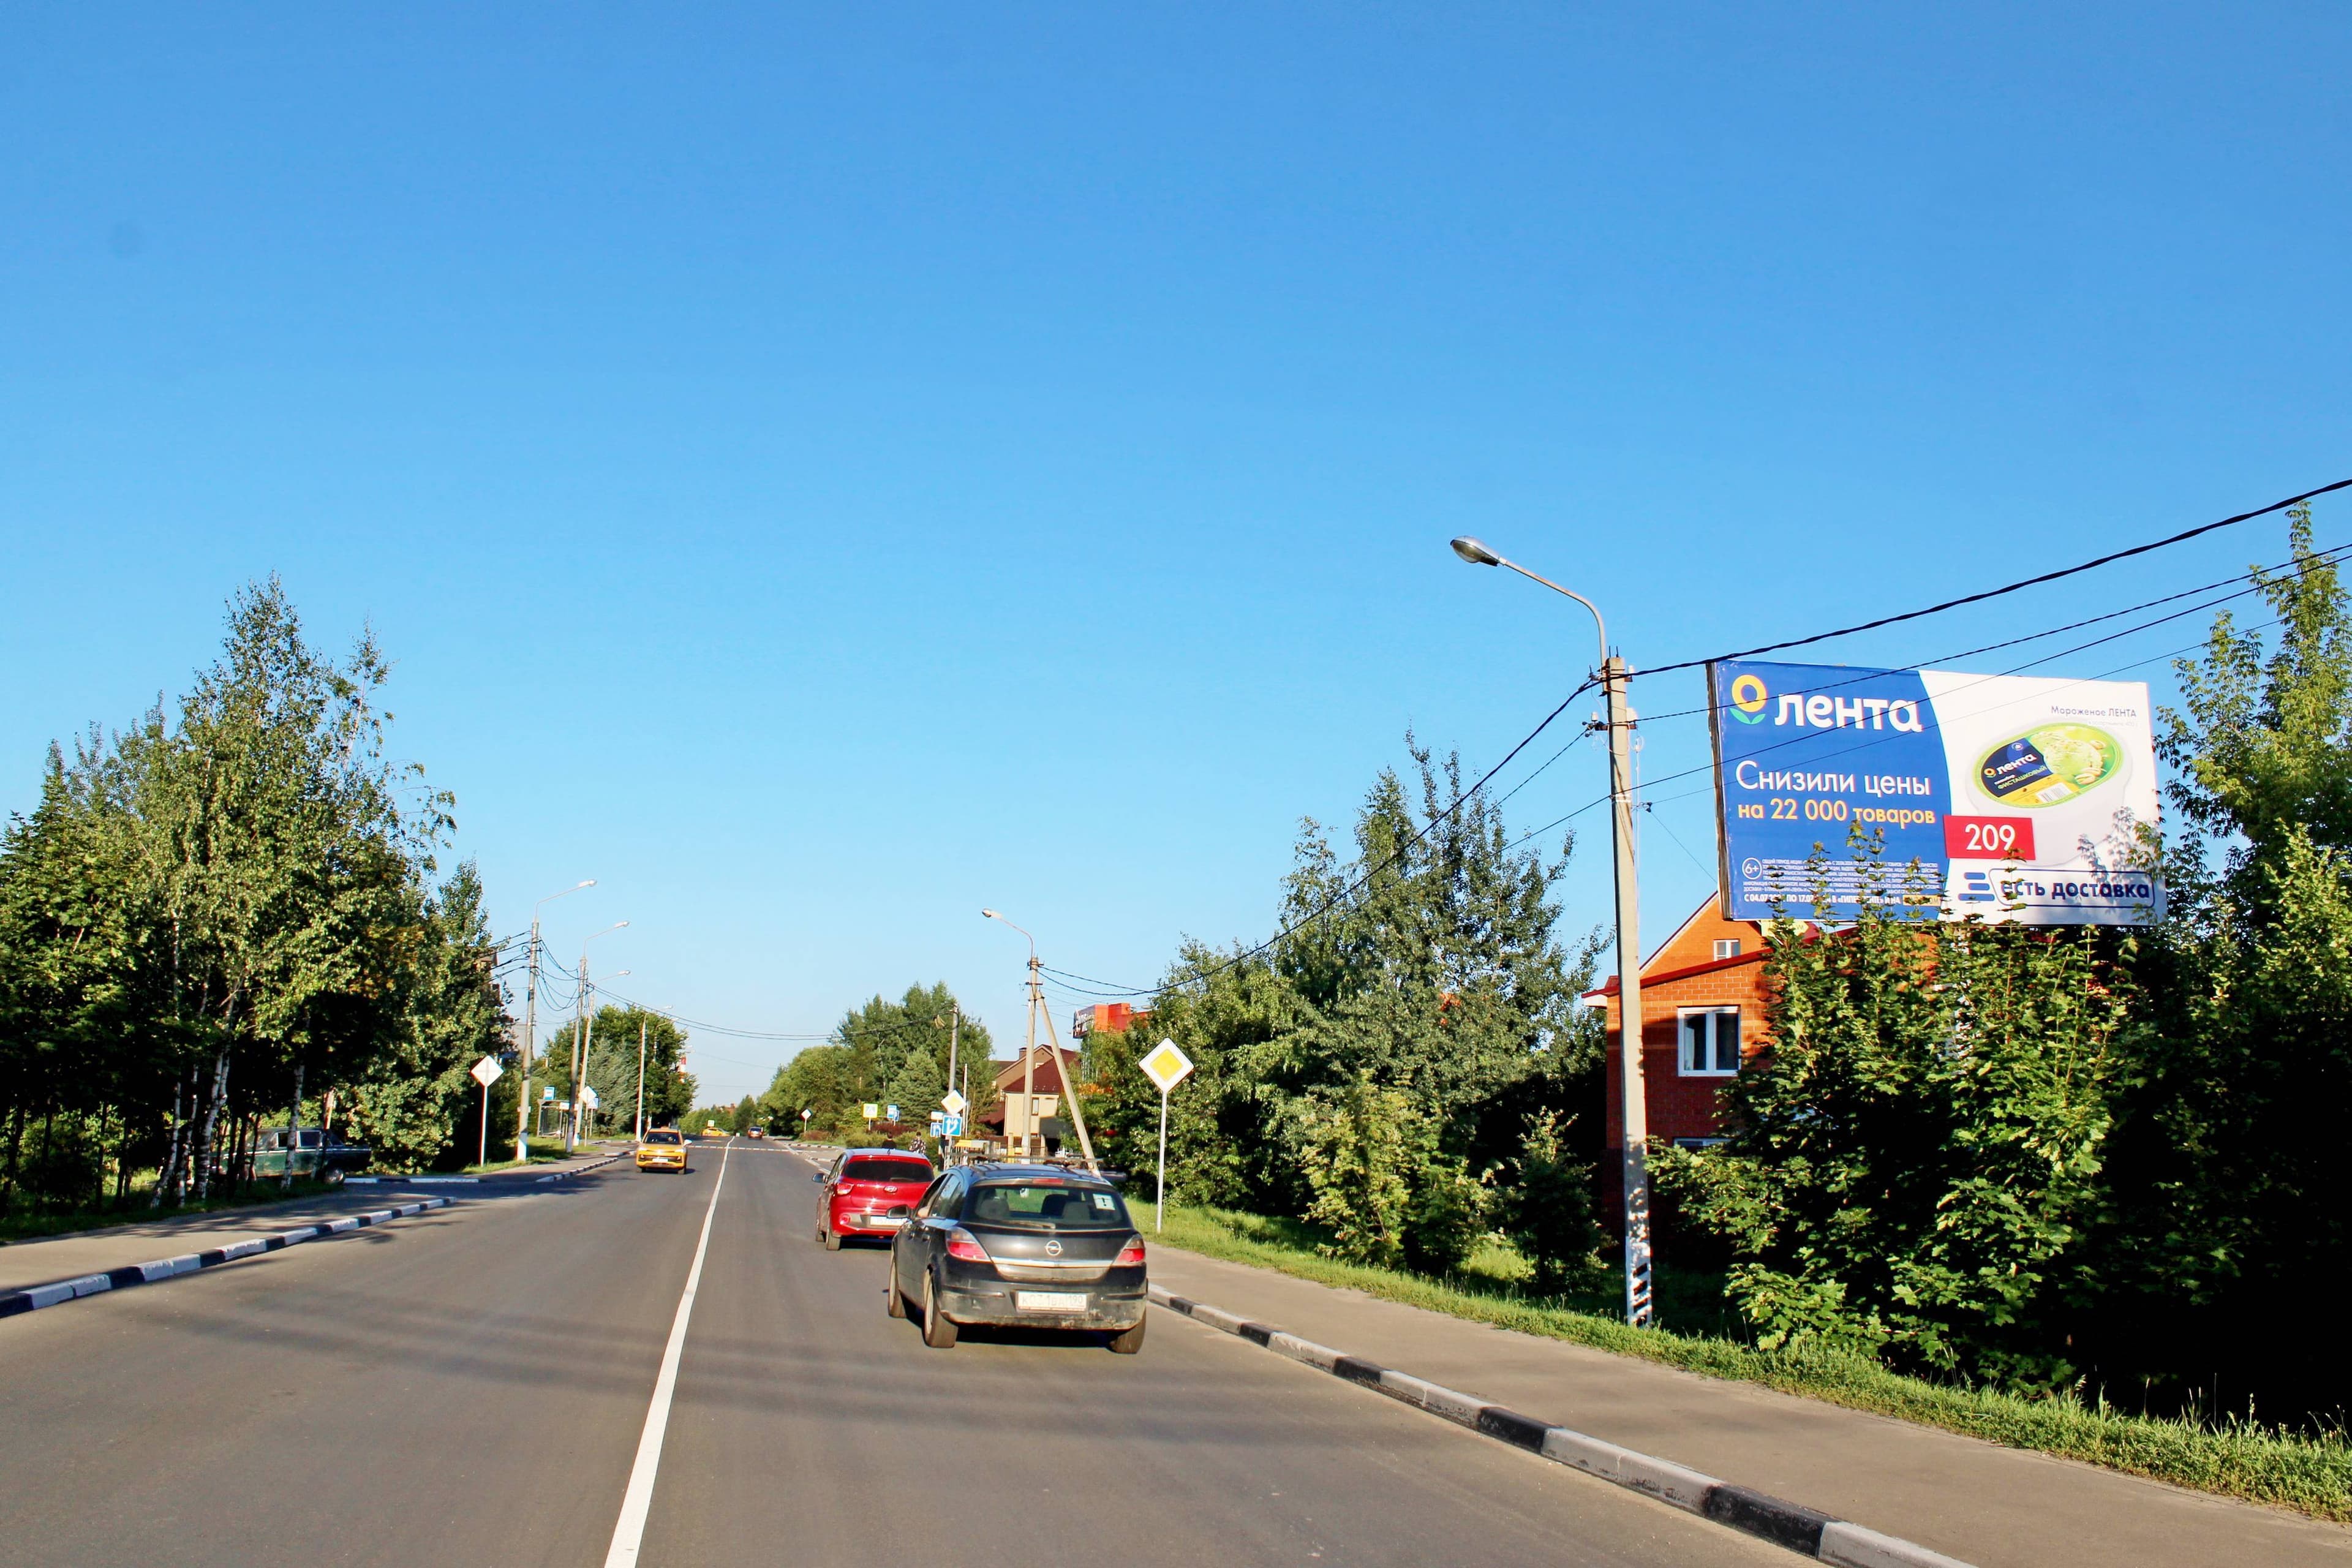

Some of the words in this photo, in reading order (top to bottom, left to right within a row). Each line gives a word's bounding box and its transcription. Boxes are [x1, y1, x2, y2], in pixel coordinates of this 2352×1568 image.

[1774, 693, 1923, 733] лента
[2051, 706, 2106, 717] Мороженое
[2108, 707, 2136, 717] ЛЕНТА
[1996, 753, 2038, 775] лента
[1735, 760, 1856, 793] Снизили
[1864, 775, 1931, 798] цены
[1738, 804, 1765, 820] на
[1770, 797, 1798, 821] 22
[1804, 799, 1847, 822] 000
[1852, 807, 1936, 830] товаров
[1965, 823, 2016, 851] 209
[1744, 863, 1760, 875] 6+
[2001, 880, 2046, 897] есть
[2052, 882, 2150, 900] доставка
